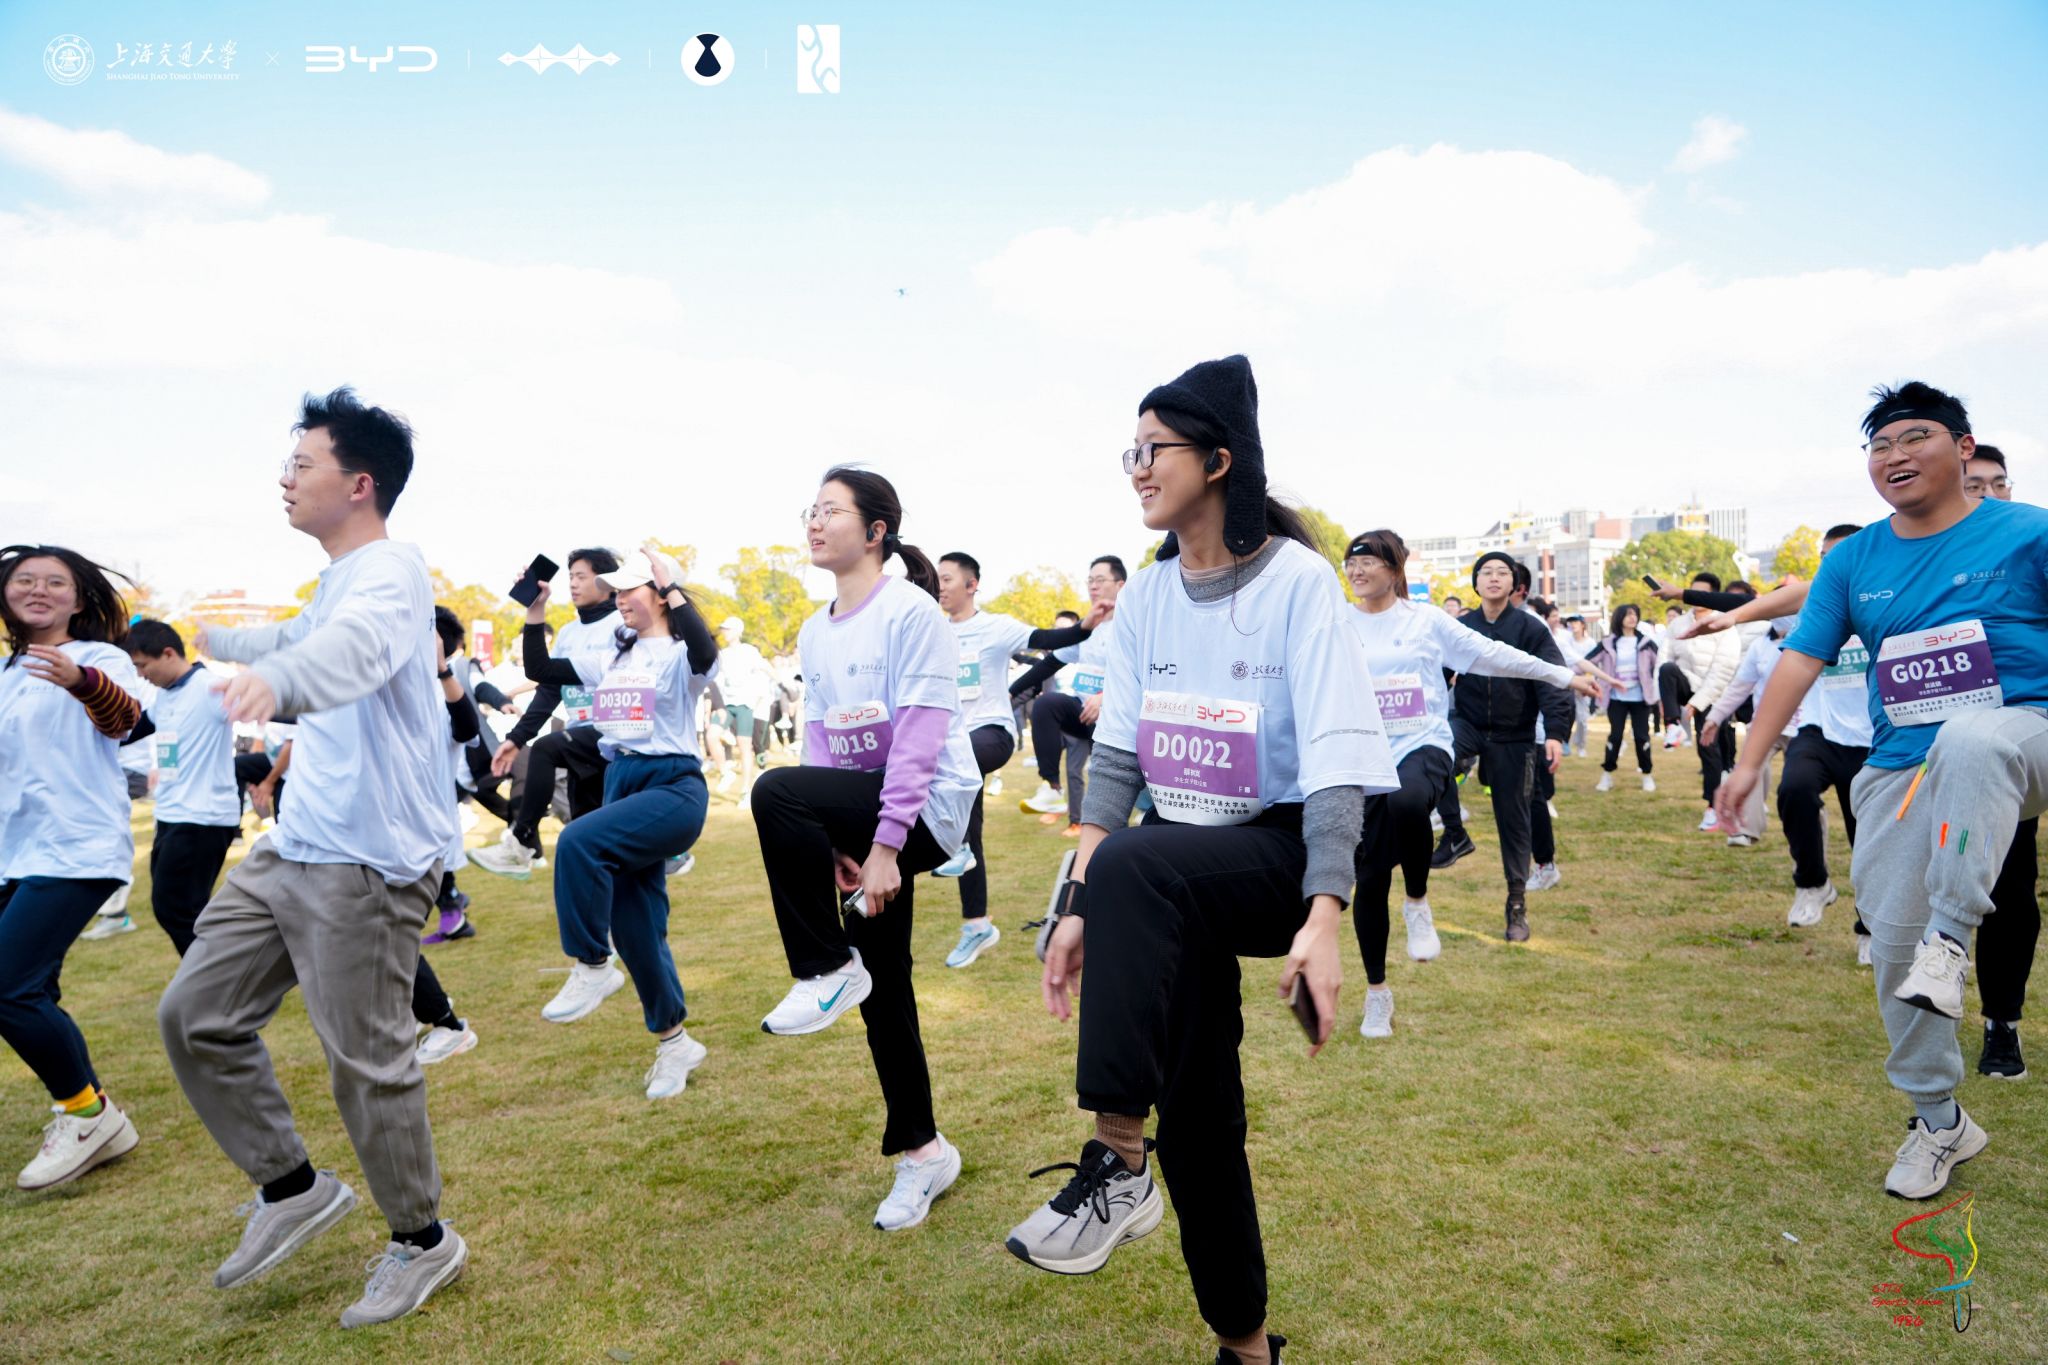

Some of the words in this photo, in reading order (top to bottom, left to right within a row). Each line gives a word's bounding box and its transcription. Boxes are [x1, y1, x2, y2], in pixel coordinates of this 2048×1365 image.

[1858, 590, 1894, 602] BYD
[1924, 628, 1977, 648] BYD
[1891, 651, 1972, 684] G0218
[600, 692, 642, 708] D0302
[839, 707, 879, 723] BYD
[1197, 705, 1246, 723] BYD
[1153, 731, 1232, 769] D0022
